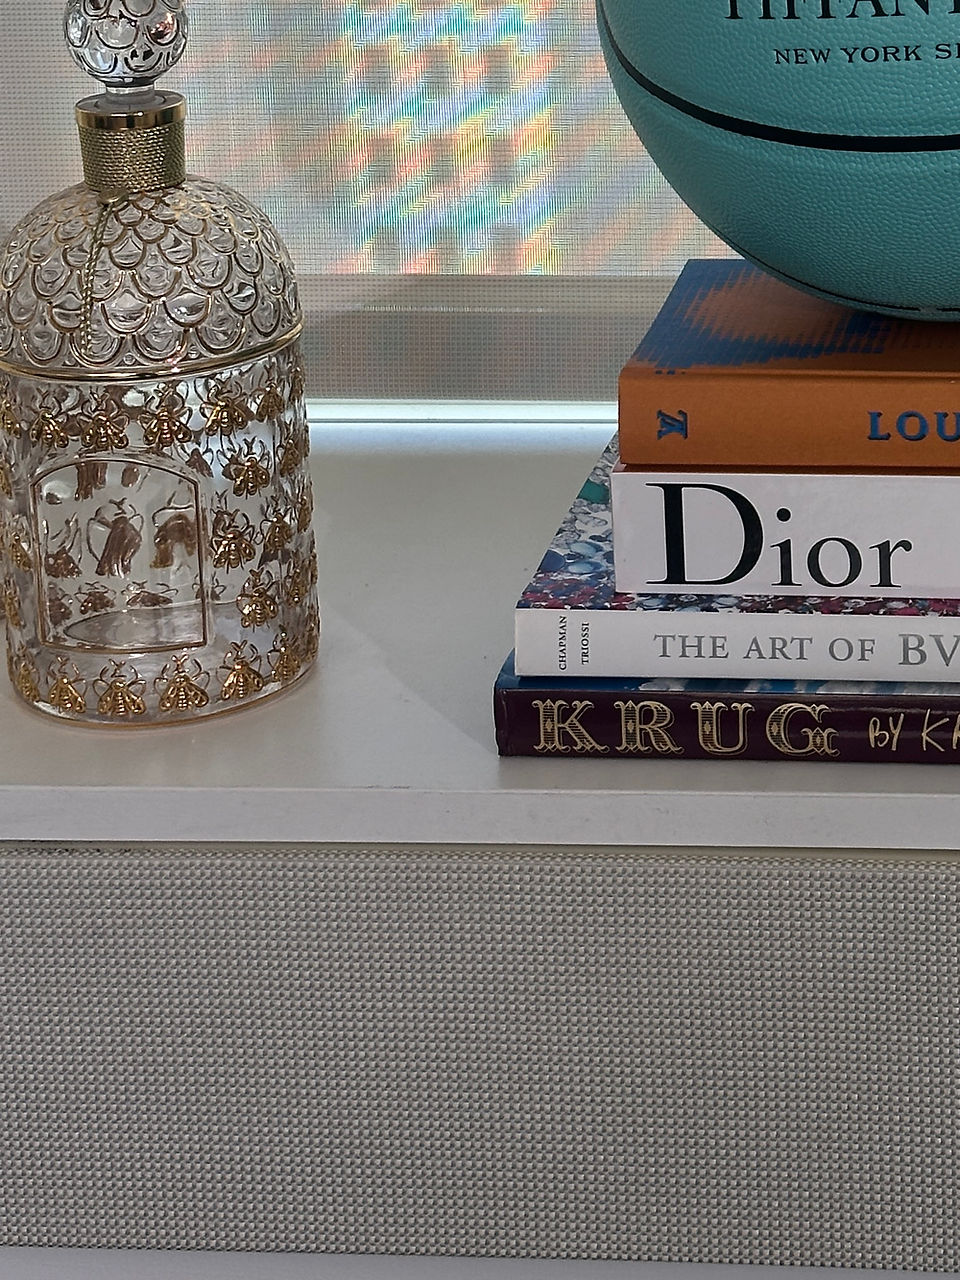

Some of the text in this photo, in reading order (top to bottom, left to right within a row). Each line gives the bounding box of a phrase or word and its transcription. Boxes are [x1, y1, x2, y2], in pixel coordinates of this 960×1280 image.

[773, 48, 831, 65] NEW
[840, 45, 921, 63] YORK
[645, 482, 913, 588] Dior
[557, 615, 568, 672] CHAPMAN
[581, 621, 590, 666] TRIOSSI
[653, 634, 729, 661] THE
[743, 635, 813, 662] ART
[828, 637, 877, 662] OF
[532, 698, 840, 757] KRUG
[869, 711, 903, 750] BY
